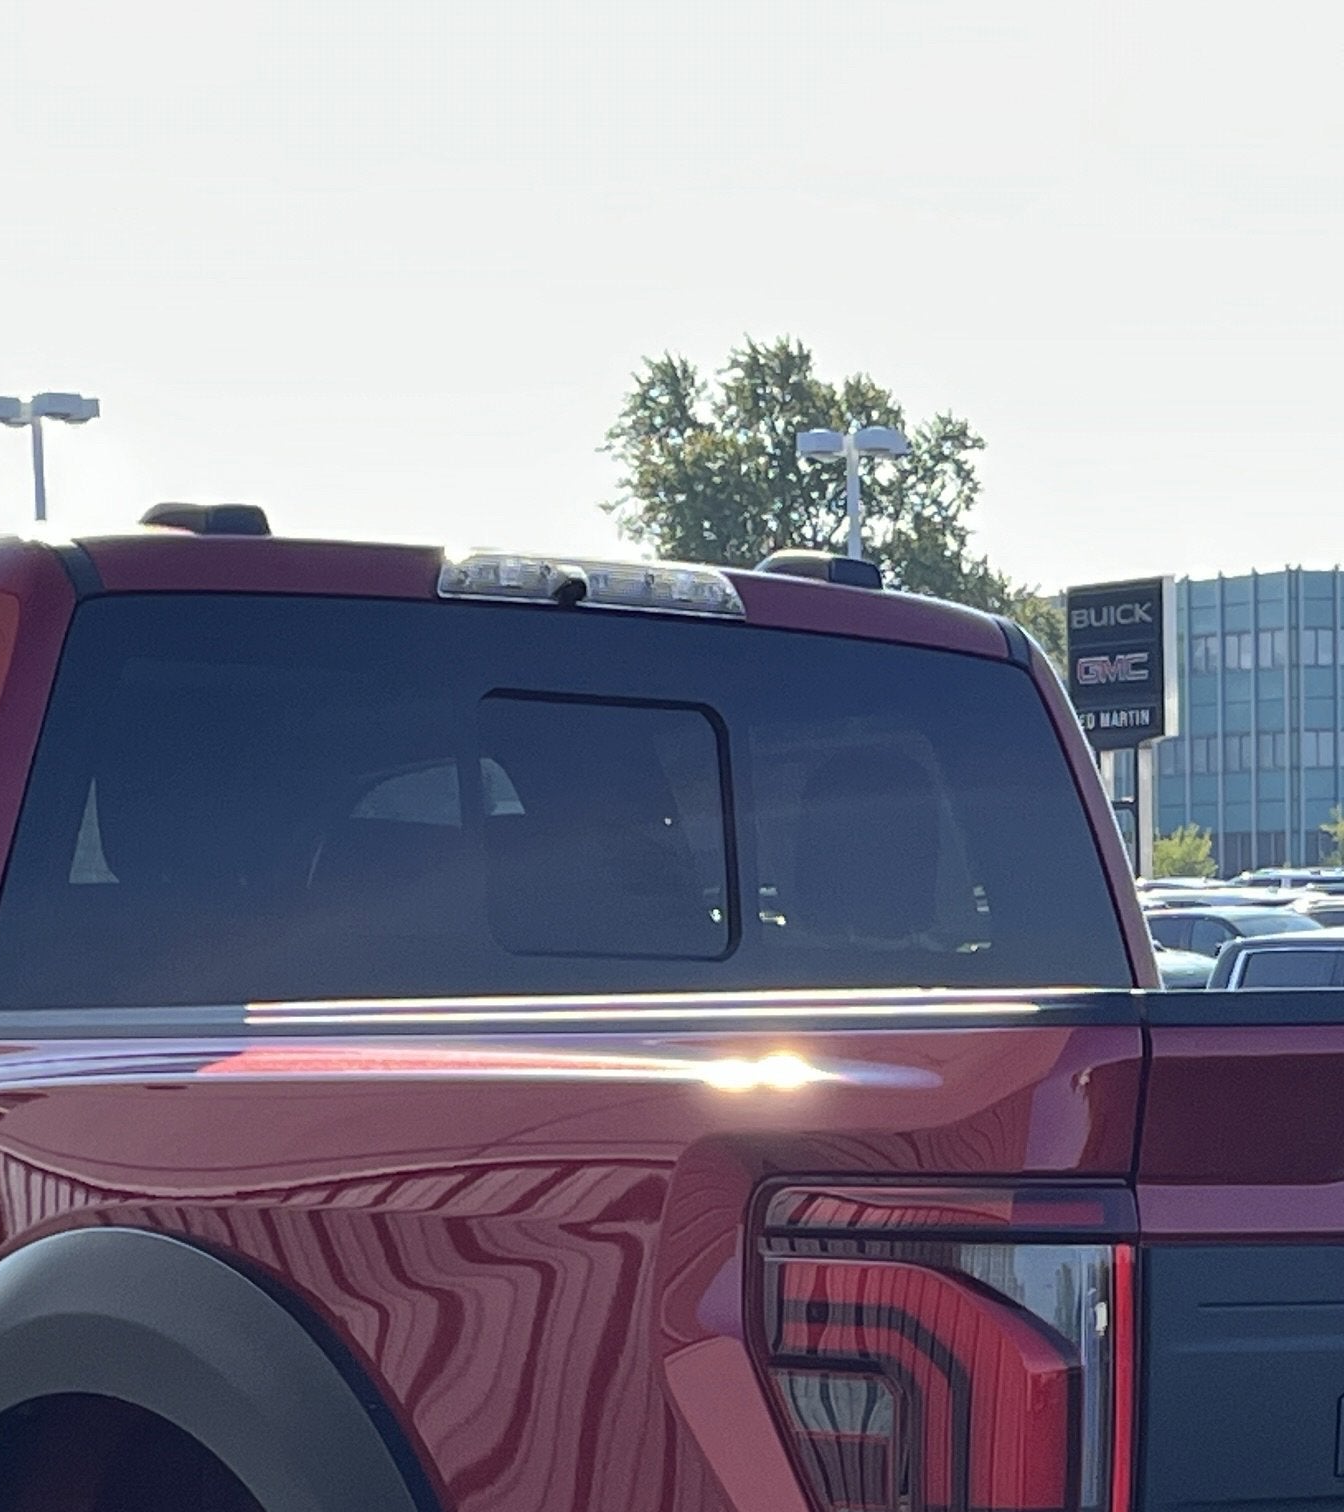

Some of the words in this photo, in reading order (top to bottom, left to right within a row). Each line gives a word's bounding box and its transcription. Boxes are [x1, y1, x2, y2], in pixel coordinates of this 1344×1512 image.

[1070, 602, 1153, 629] BUICK
[1076, 652, 1150, 685] GMC
[1100, 708, 1150, 729] MARTIN
